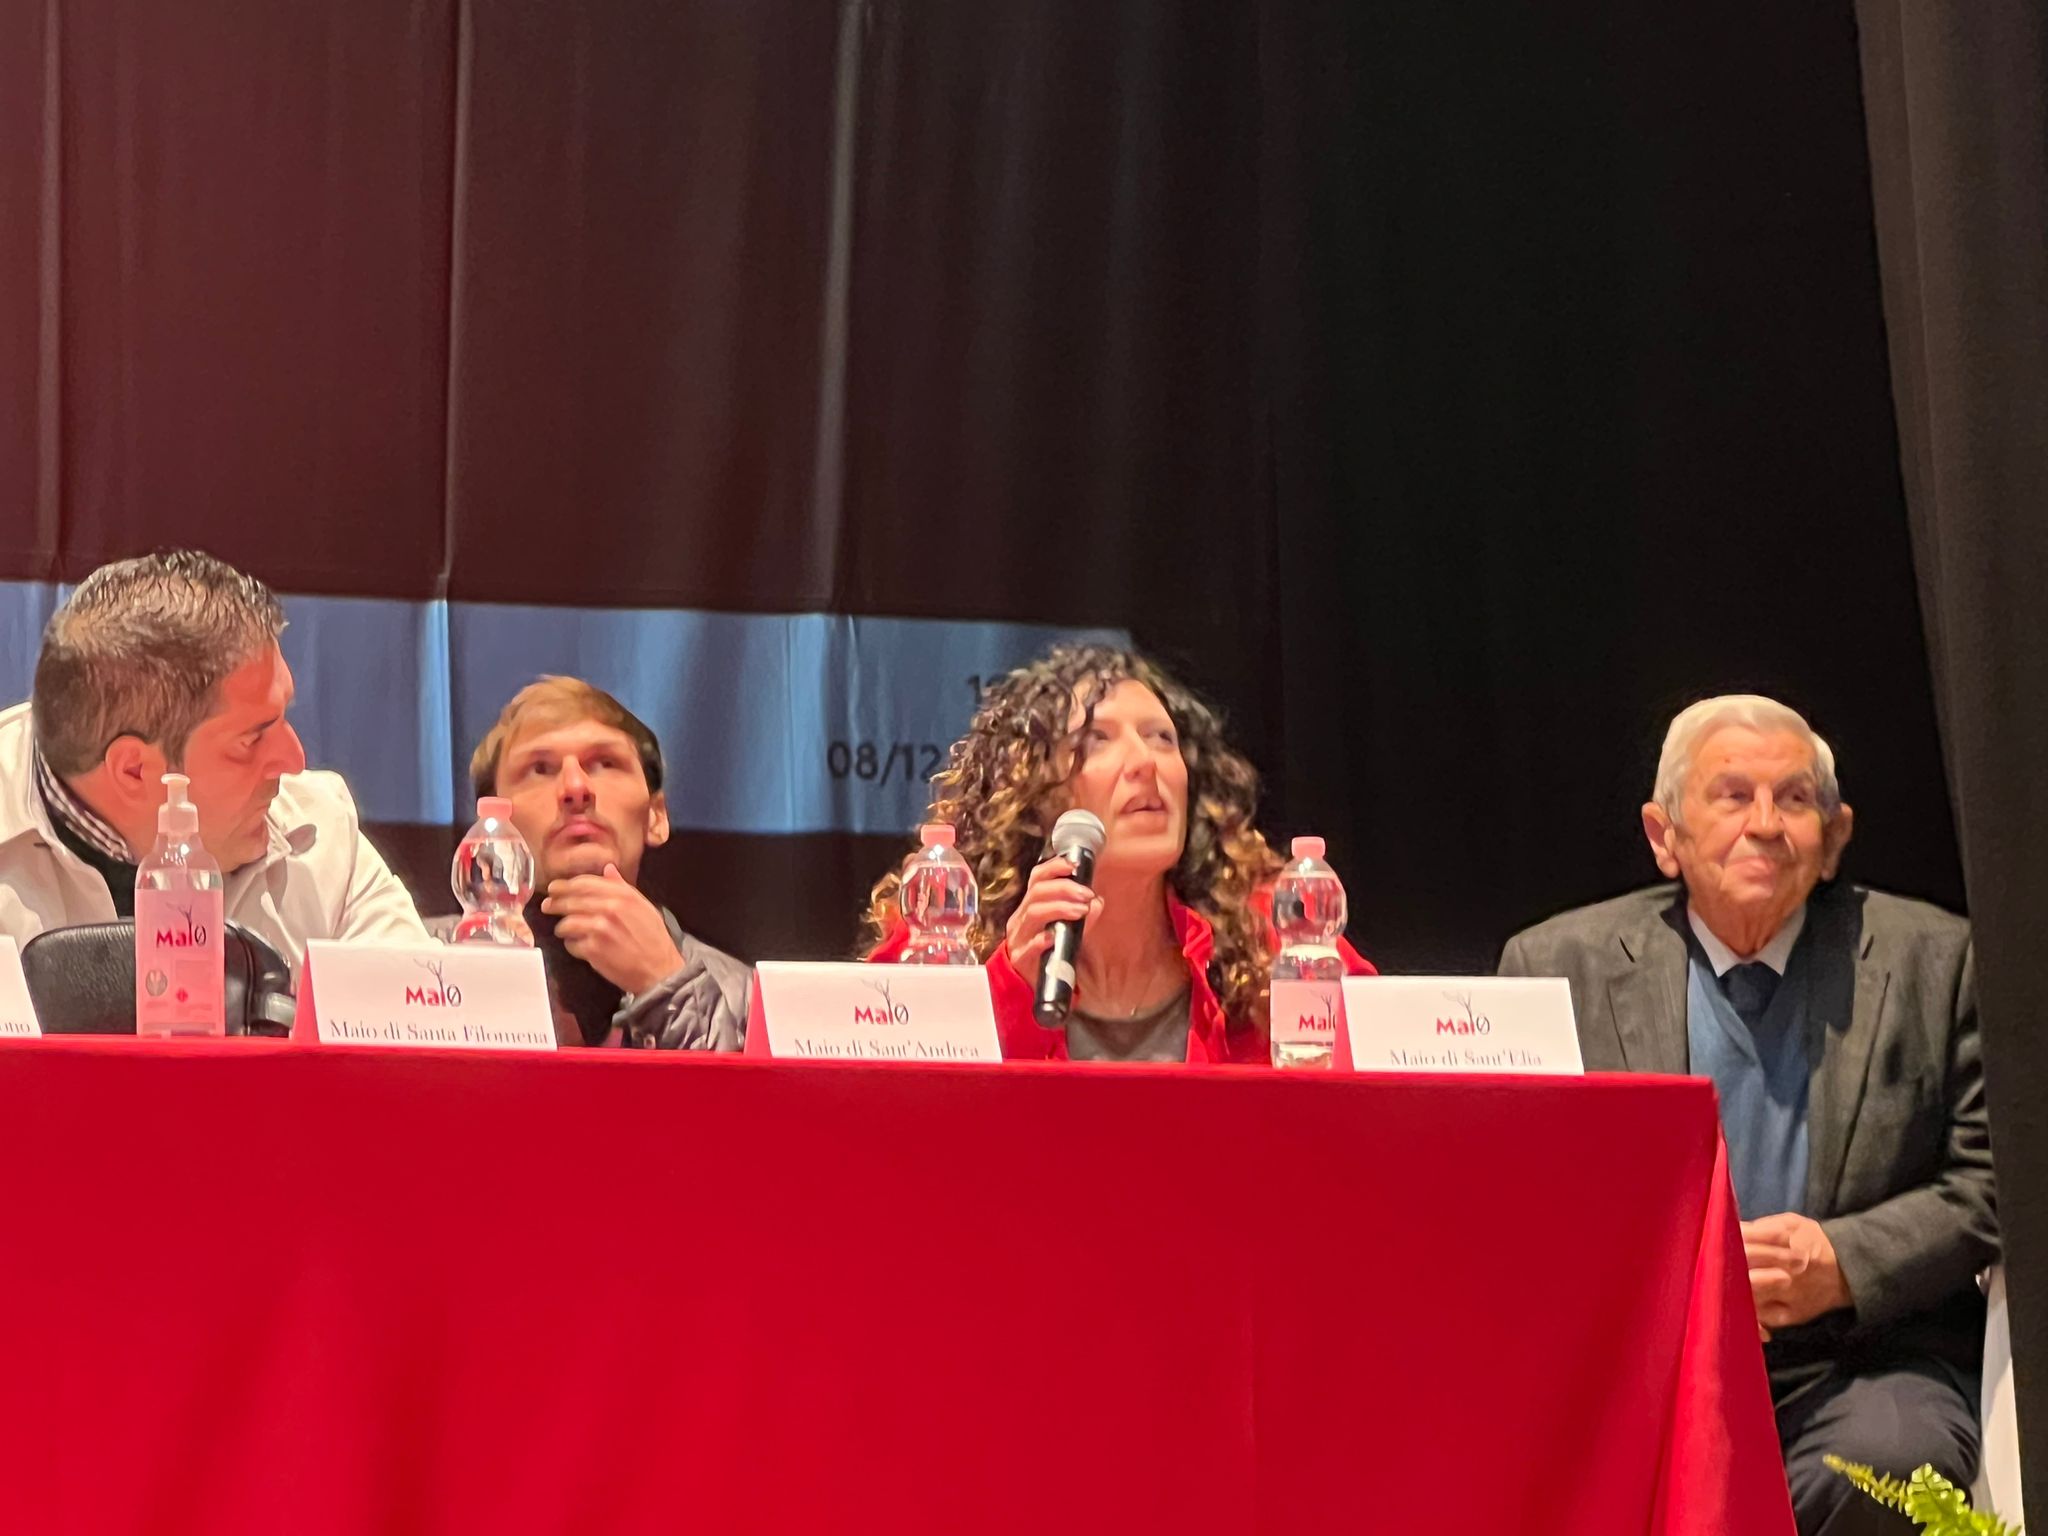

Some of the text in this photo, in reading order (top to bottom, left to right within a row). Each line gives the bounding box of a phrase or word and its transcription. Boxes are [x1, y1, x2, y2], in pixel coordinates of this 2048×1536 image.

[827, 740, 942, 786] 08/12
[330, 1019, 549, 1044] Maio di Santa Filomena
[794, 1038, 980, 1059] Maio di Sant'Andrea
[1390, 1048, 1543, 1067] Maio di Sant'Elia
